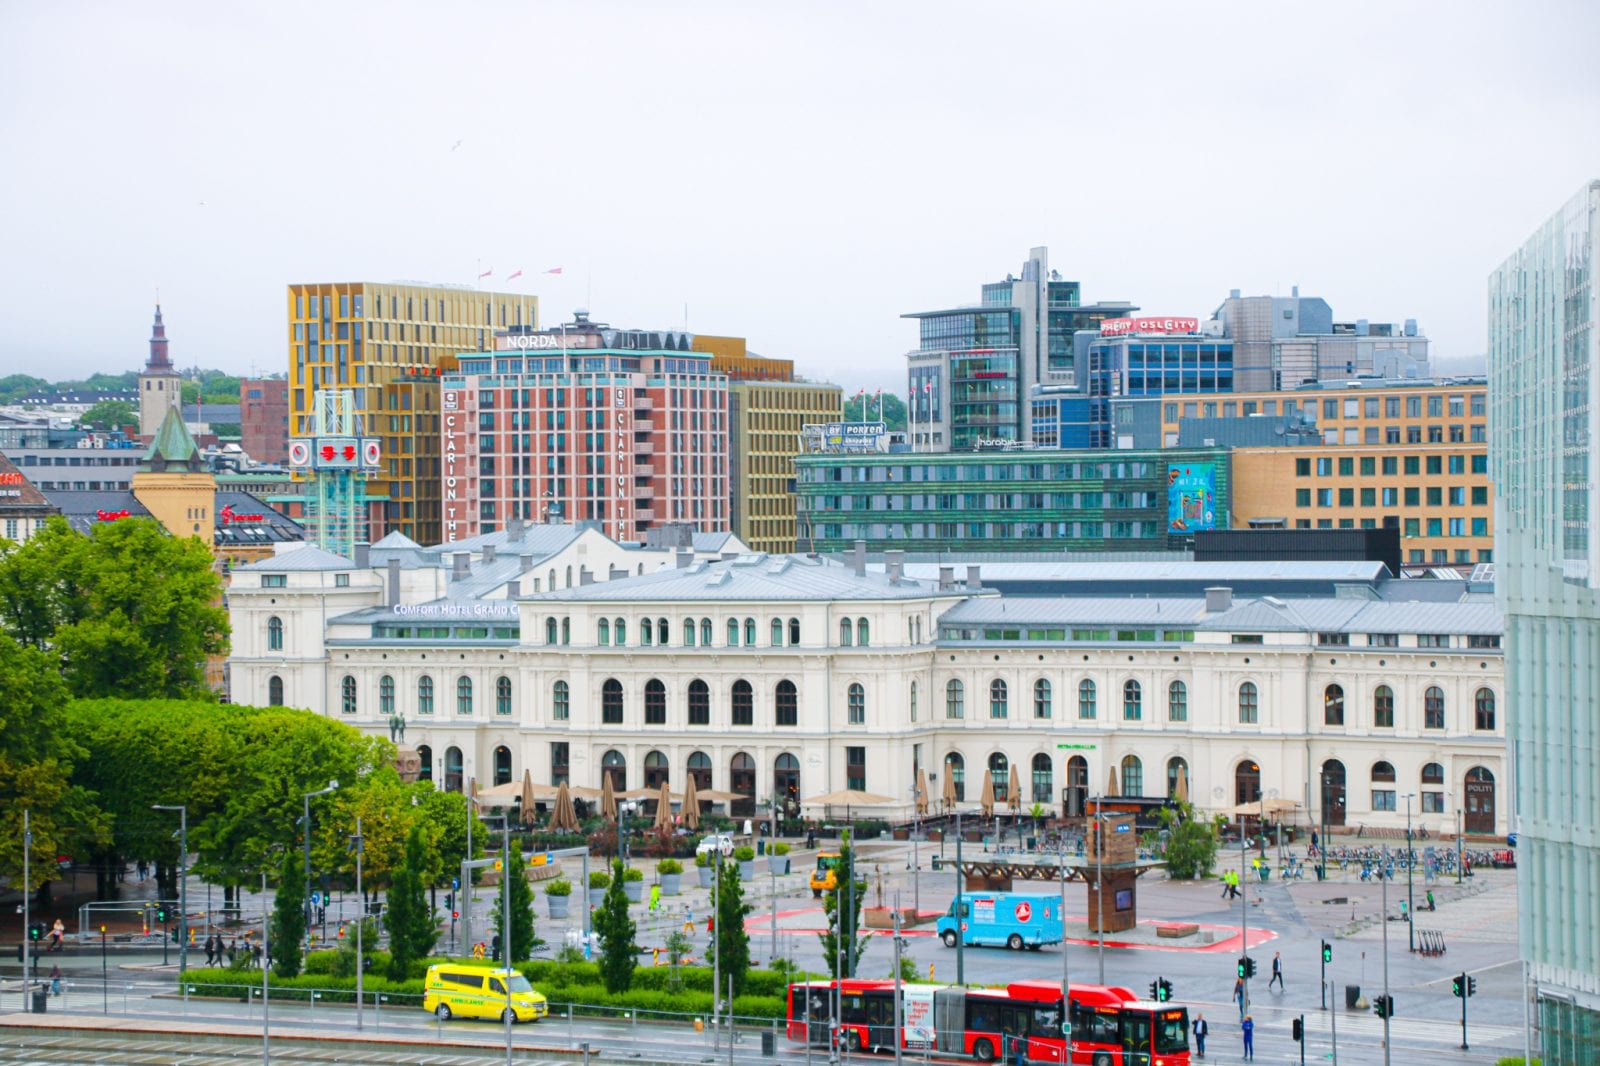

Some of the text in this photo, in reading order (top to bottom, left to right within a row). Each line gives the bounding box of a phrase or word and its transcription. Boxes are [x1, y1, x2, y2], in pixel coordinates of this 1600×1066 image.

[507, 335, 558, 349] NORDA
[829, 426, 840, 434] BY
[446, 416, 456, 500] CLARION
[617, 413, 625, 499] CLARION
[448, 507, 456, 543] THE
[1467, 784, 1493, 792] POLITI
